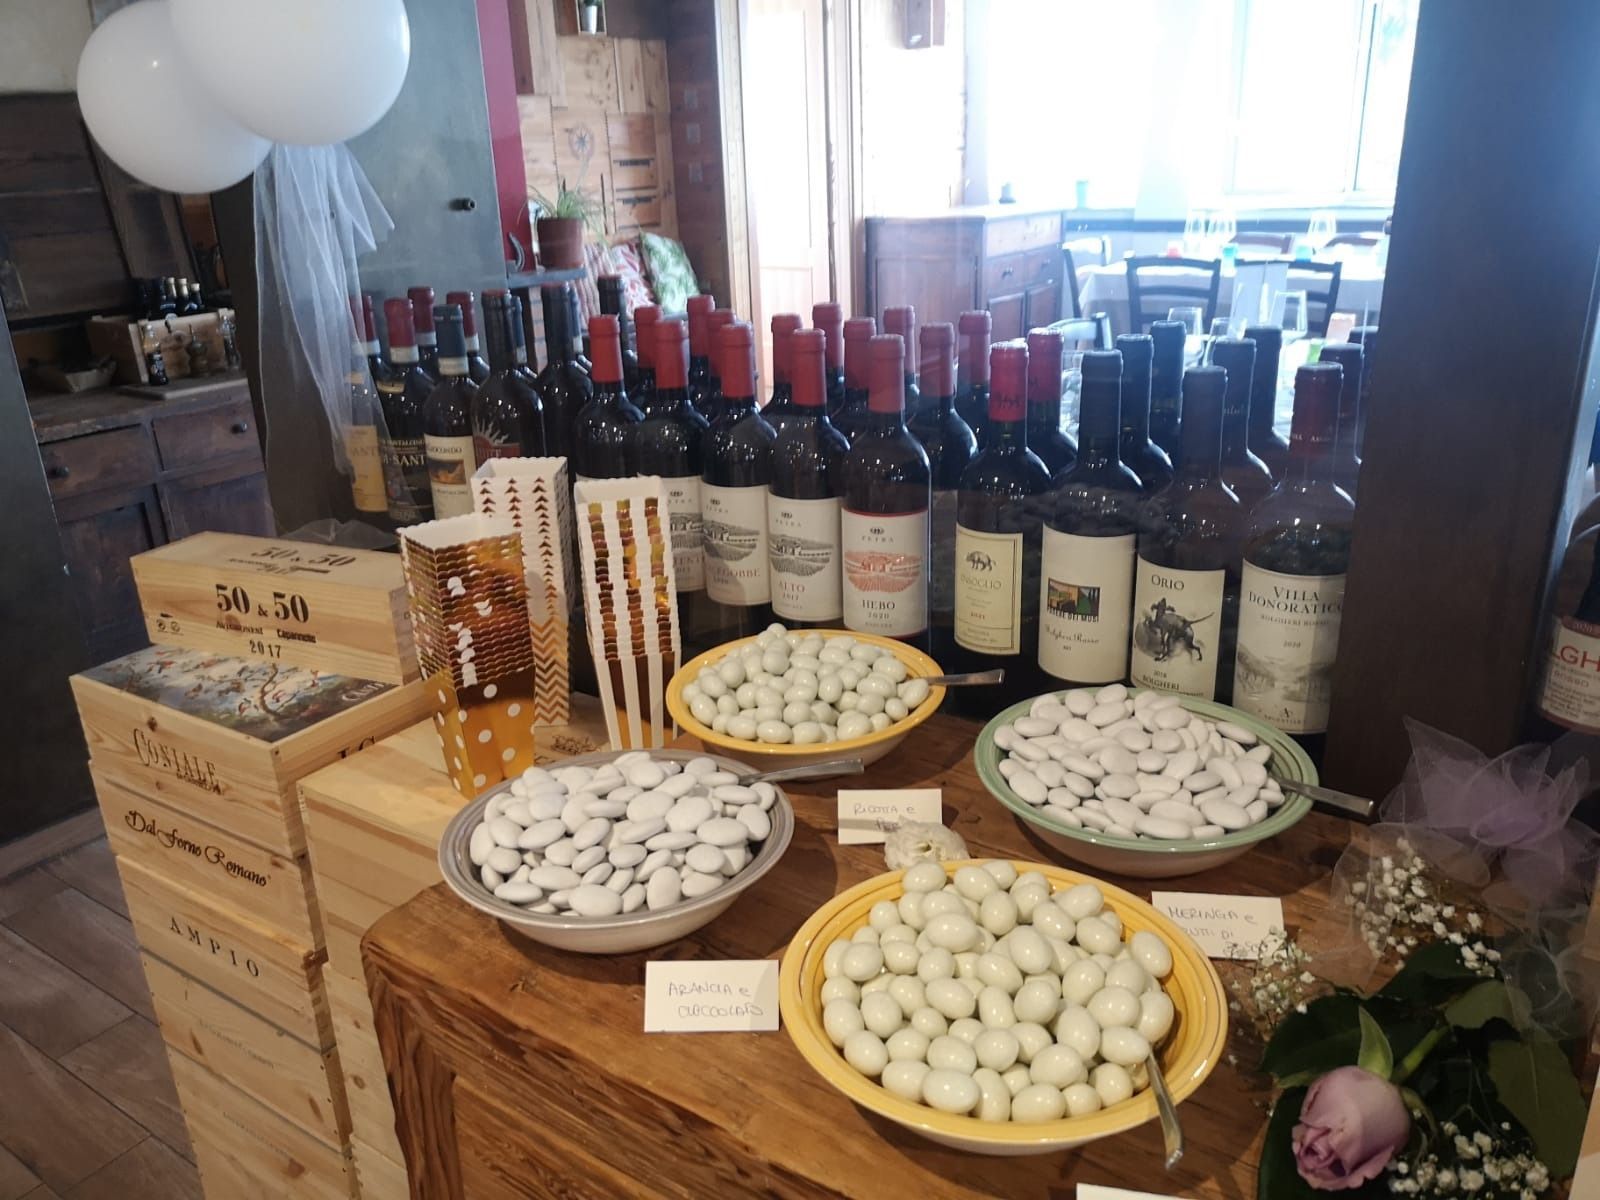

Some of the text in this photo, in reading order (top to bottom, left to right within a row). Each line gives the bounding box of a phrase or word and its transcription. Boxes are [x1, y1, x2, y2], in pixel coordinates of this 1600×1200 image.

[1151, 574, 1185, 591] ORIO
[1273, 585, 1321, 602] VILLA
[215, 583, 310, 624] 50 & 50
[862, 599, 896, 611] HEBO
[249, 639, 282, 659] 2017
[124, 809, 268, 887] Dal Forno Romano
[169, 915, 260, 978] AMPIO
[668, 981, 733, 996] ARANCIA
